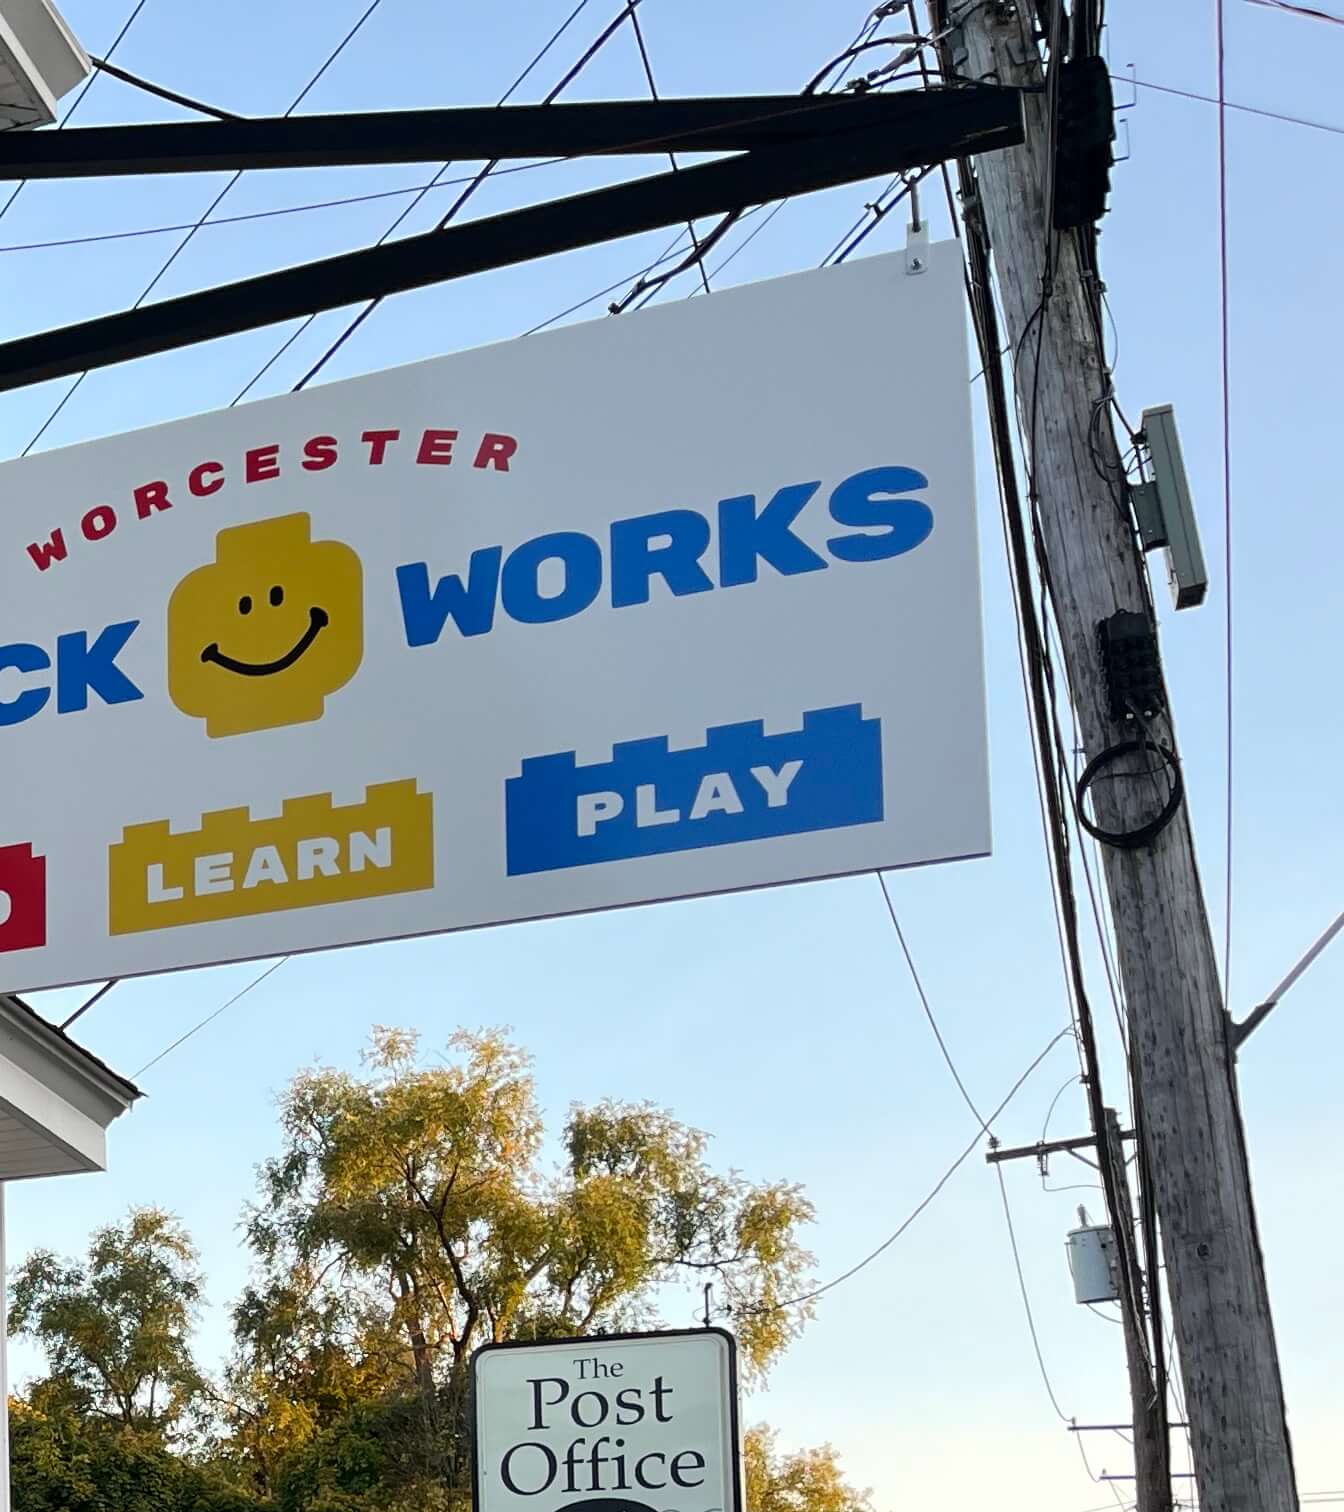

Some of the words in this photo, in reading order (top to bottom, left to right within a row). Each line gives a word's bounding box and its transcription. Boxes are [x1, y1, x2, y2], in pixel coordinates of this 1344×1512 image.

[28, 428, 519, 570] WORCESTER
[395, 464, 934, 648] WORKS
[575, 759, 804, 836] PLAY
[145, 826, 394, 903] LEARN
[526, 1376, 673, 1431] Post
[573, 1357, 624, 1380] The
[500, 1436, 706, 1496] Office
